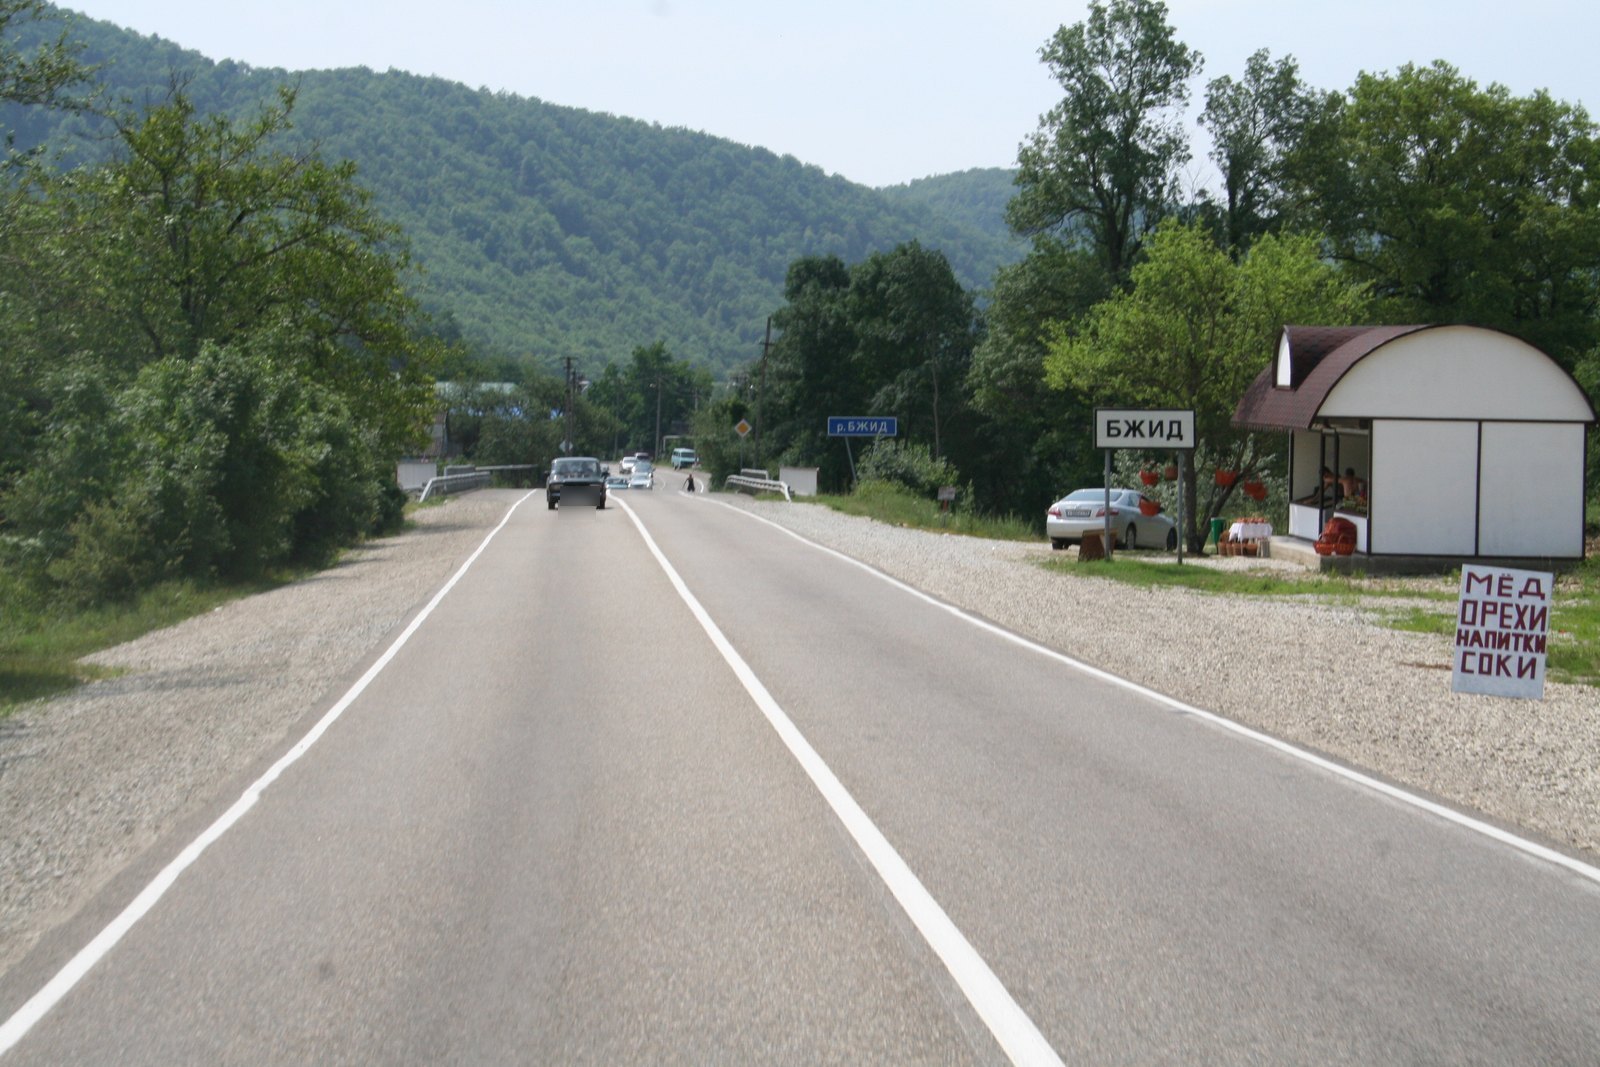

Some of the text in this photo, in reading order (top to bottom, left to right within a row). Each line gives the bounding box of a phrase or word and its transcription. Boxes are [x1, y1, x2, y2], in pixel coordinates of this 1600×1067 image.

[848, 421, 888, 433] БЖИД
[1106, 420, 1183, 441] БЖИД
[1465, 571, 1546, 600] МЁД
[1460, 599, 1547, 632] ОРЕХИ
[1456, 629, 1546, 654] НАПИТКИ
[1460, 650, 1537, 680] СОКИ
